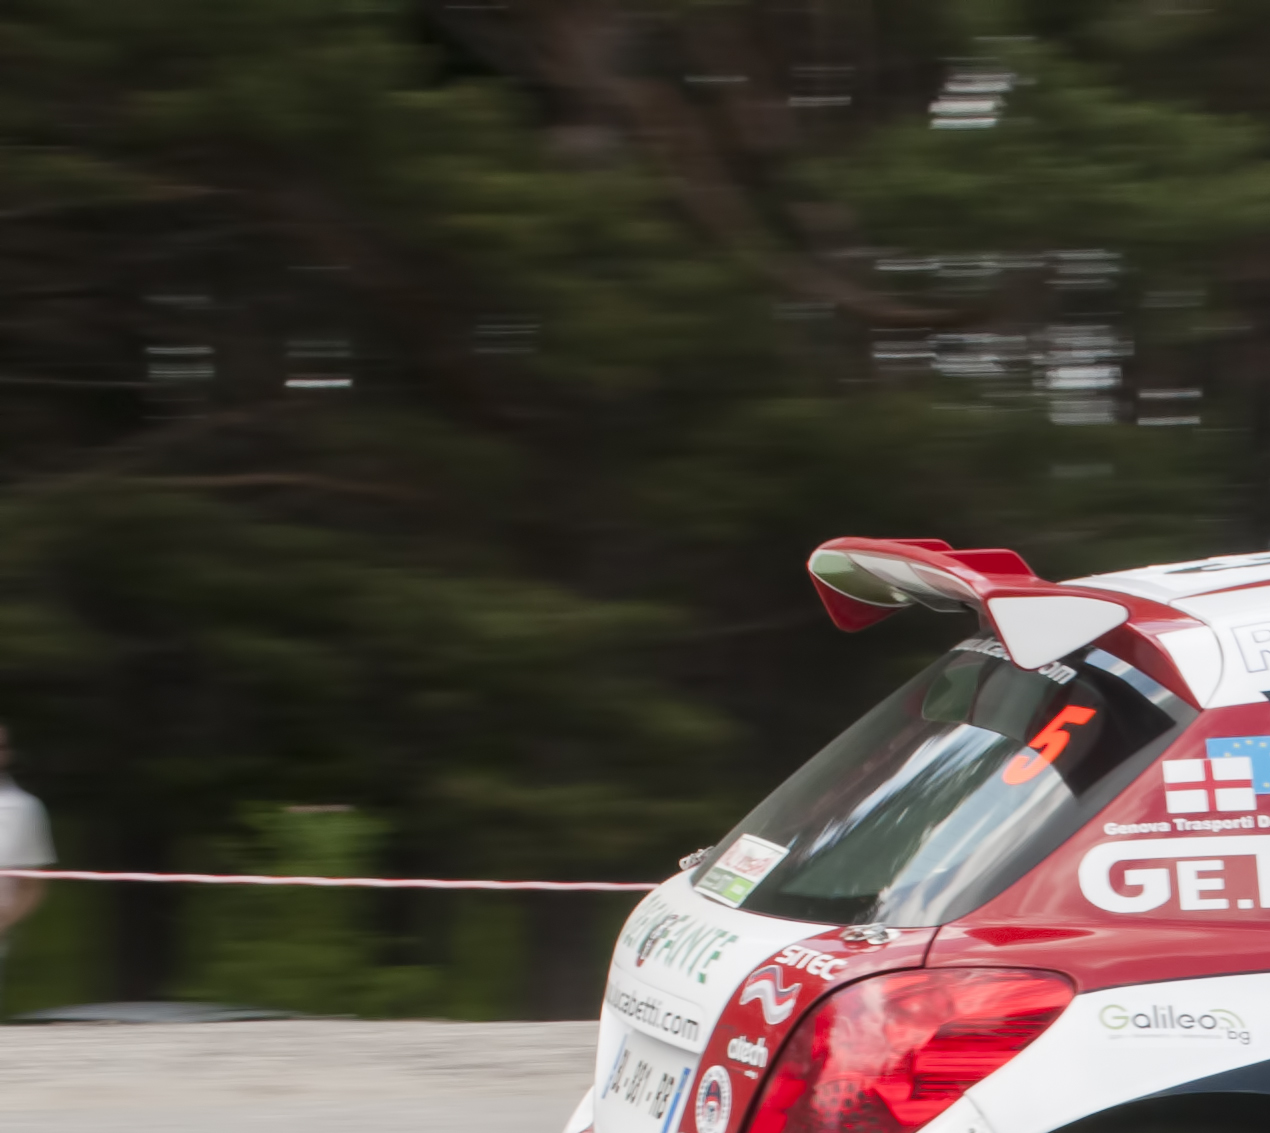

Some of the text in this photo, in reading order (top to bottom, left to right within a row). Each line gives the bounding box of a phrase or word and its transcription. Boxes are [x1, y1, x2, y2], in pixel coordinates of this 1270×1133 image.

[1002, 704, 1097, 785] 5
[1103, 821, 1171, 835] Genova
[1173, 816, 1255, 832] Trasporti
[1099, 1004, 1217, 1030] Galileo
